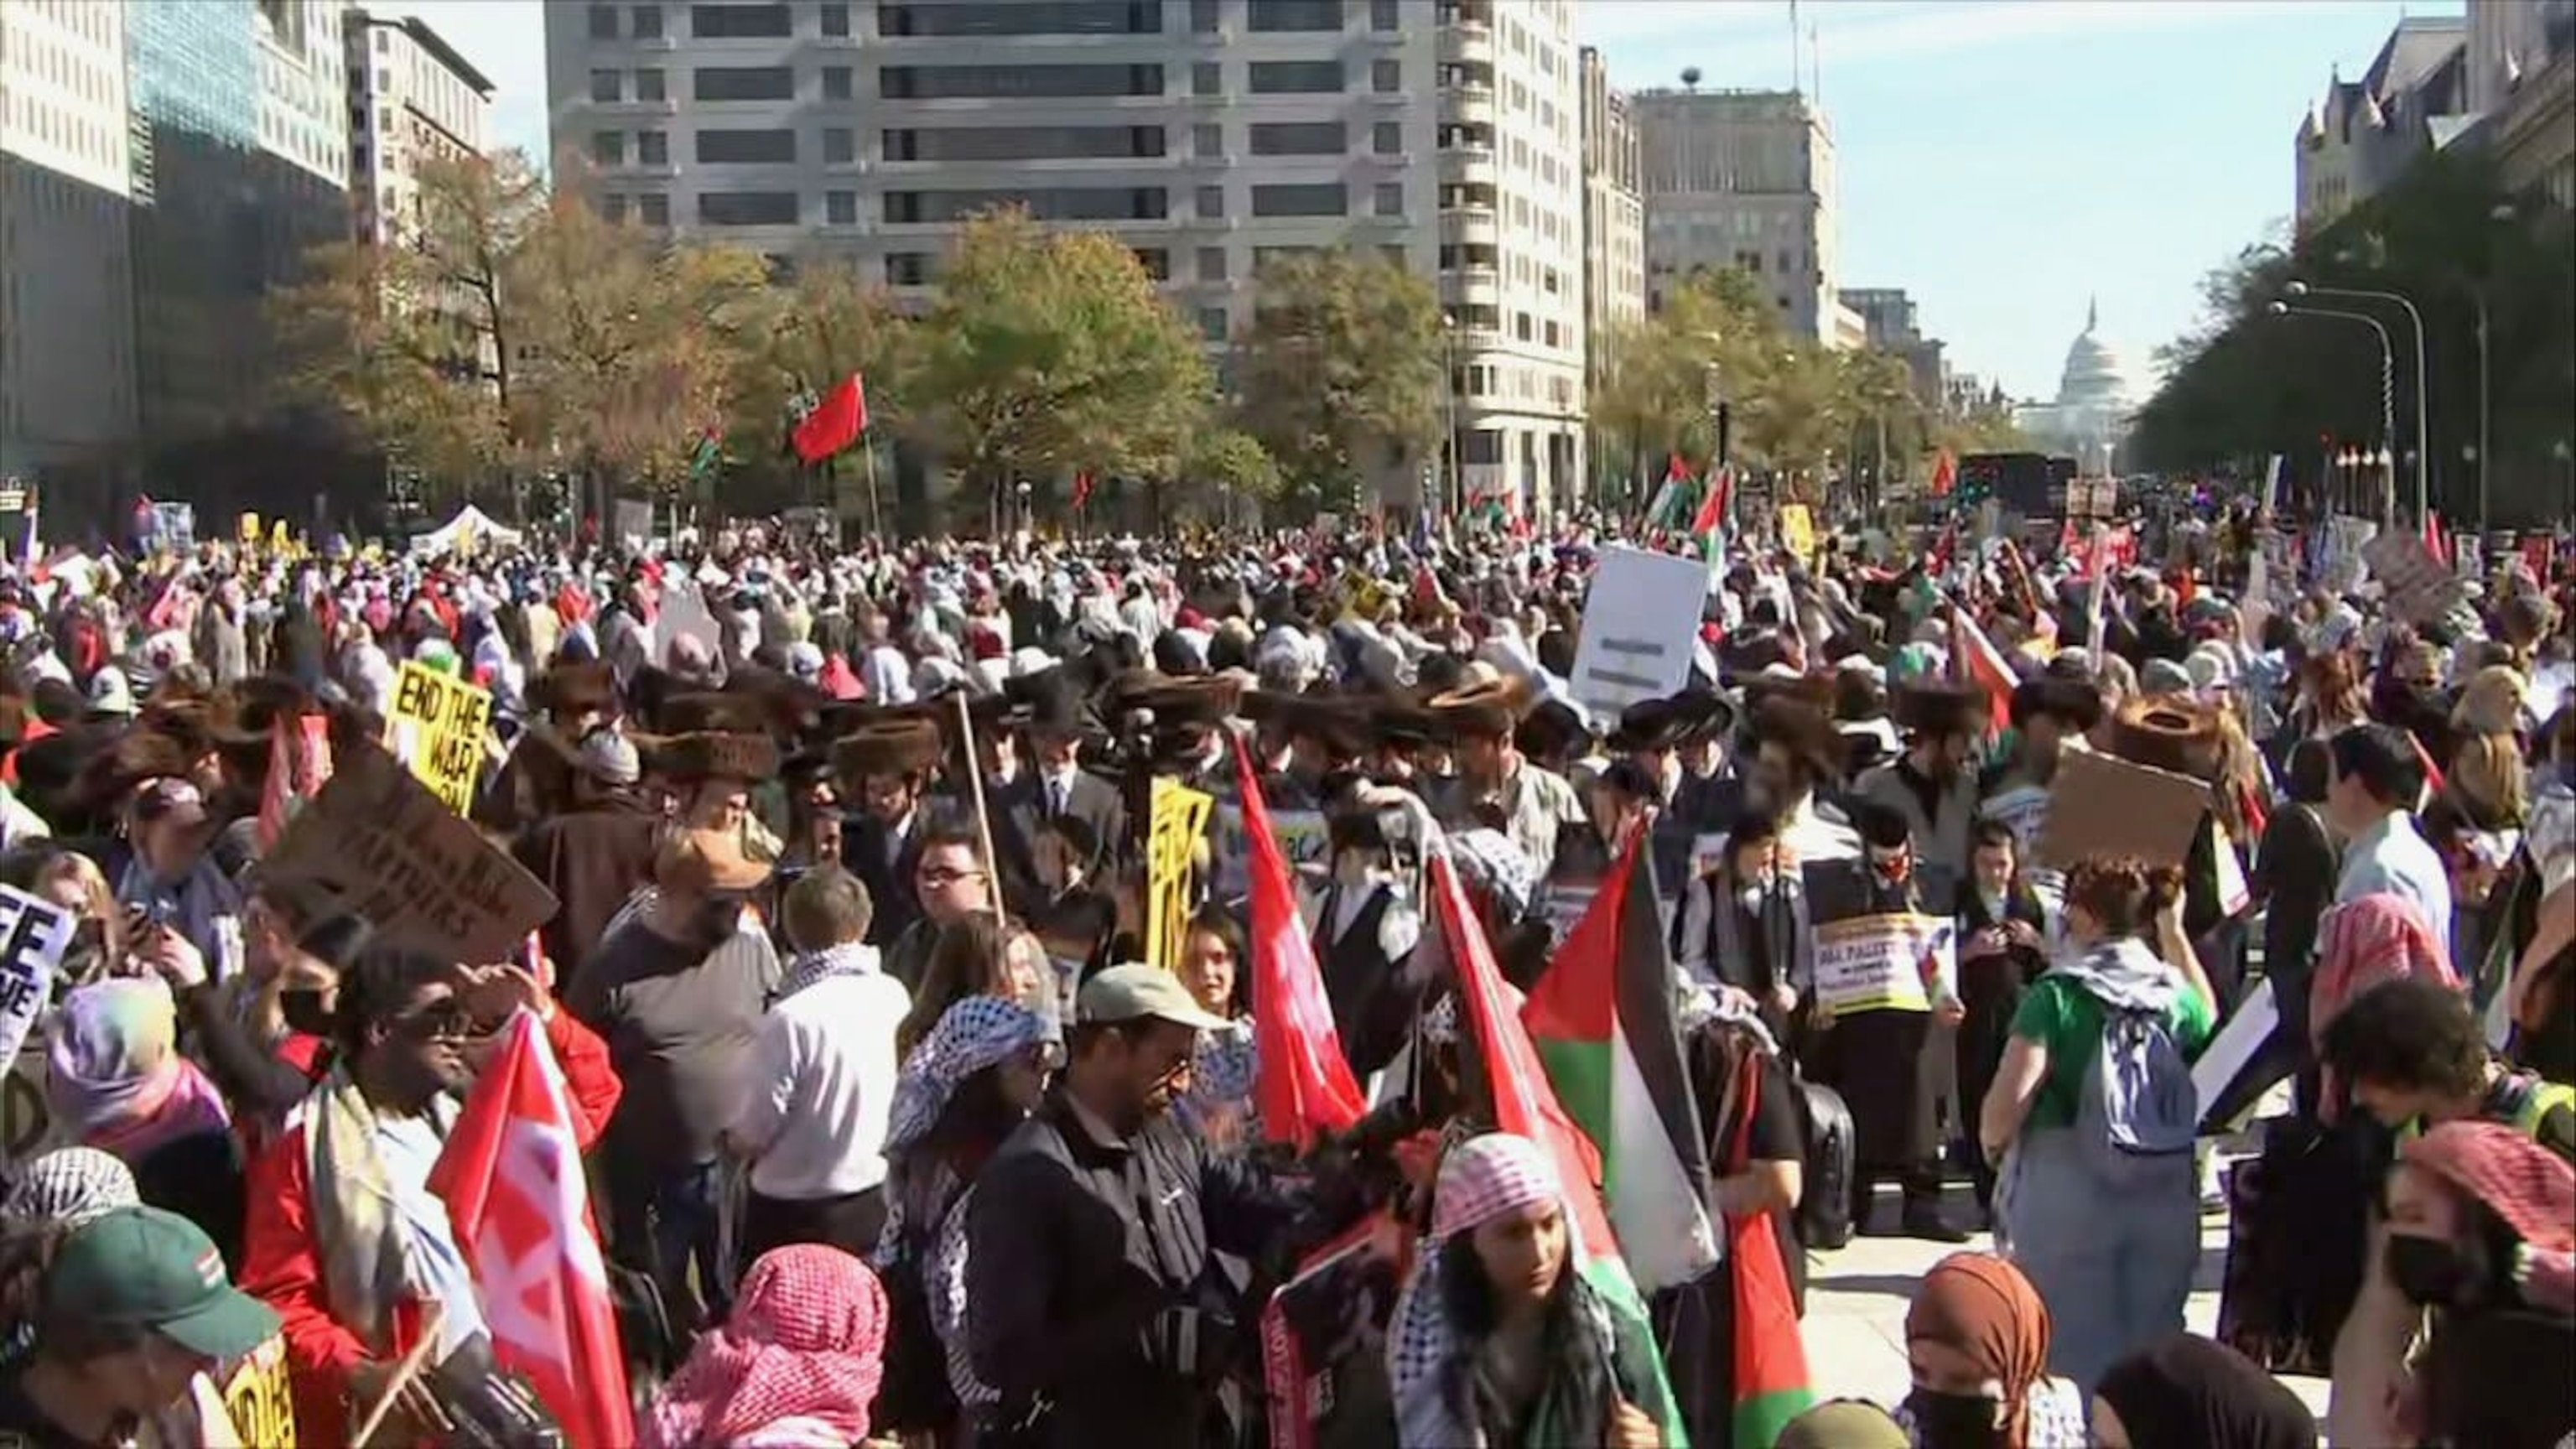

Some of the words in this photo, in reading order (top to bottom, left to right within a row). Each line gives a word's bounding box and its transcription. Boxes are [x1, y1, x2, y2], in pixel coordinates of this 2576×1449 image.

[397, 669, 443, 724] END
[445, 686, 484, 741] THE
[429, 731, 473, 783] WAR
